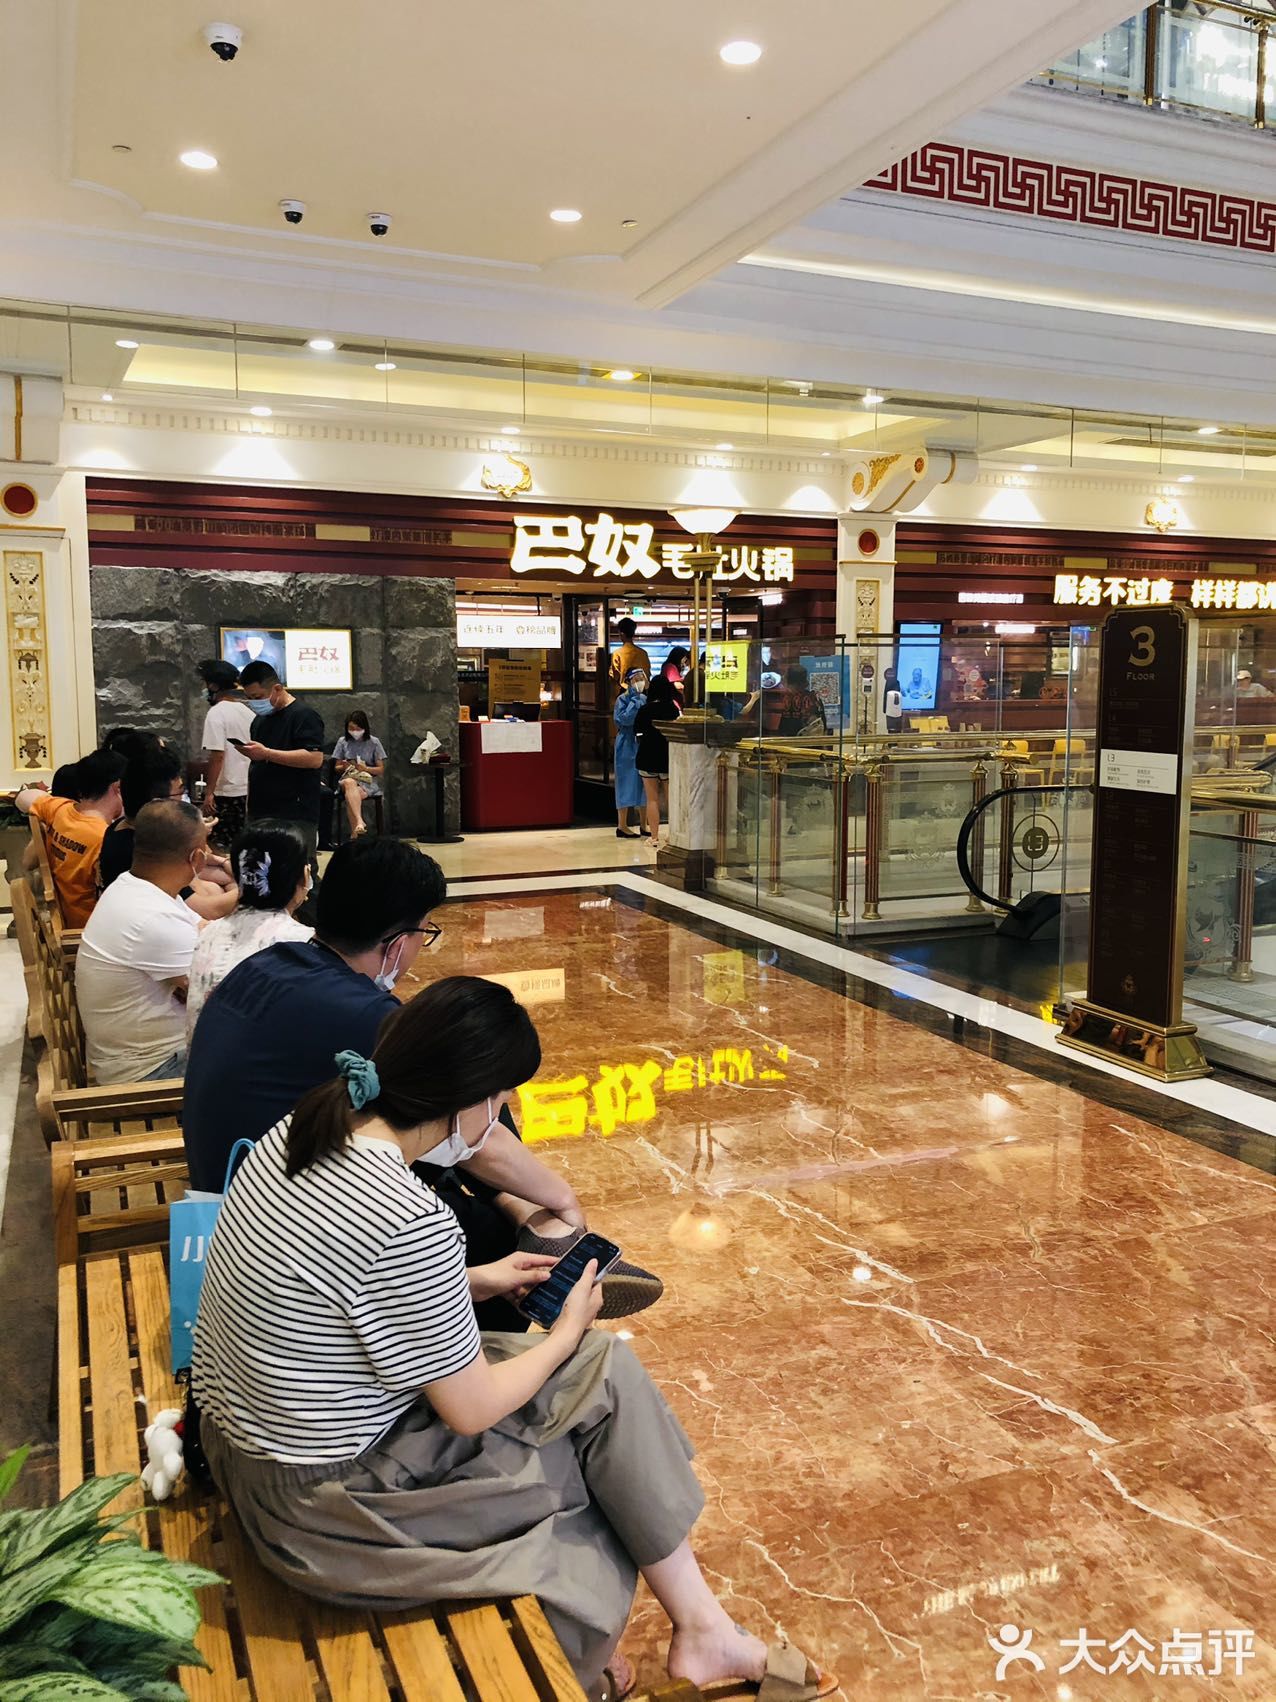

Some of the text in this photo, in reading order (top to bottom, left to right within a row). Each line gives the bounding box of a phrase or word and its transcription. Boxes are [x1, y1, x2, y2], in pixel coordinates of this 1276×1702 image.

[510, 513, 661, 579] 巴奴
[1053, 574, 1174, 605] 服务不过度
[298, 646, 339, 661] 巴奴
[1128, 626, 1156, 667] 3
